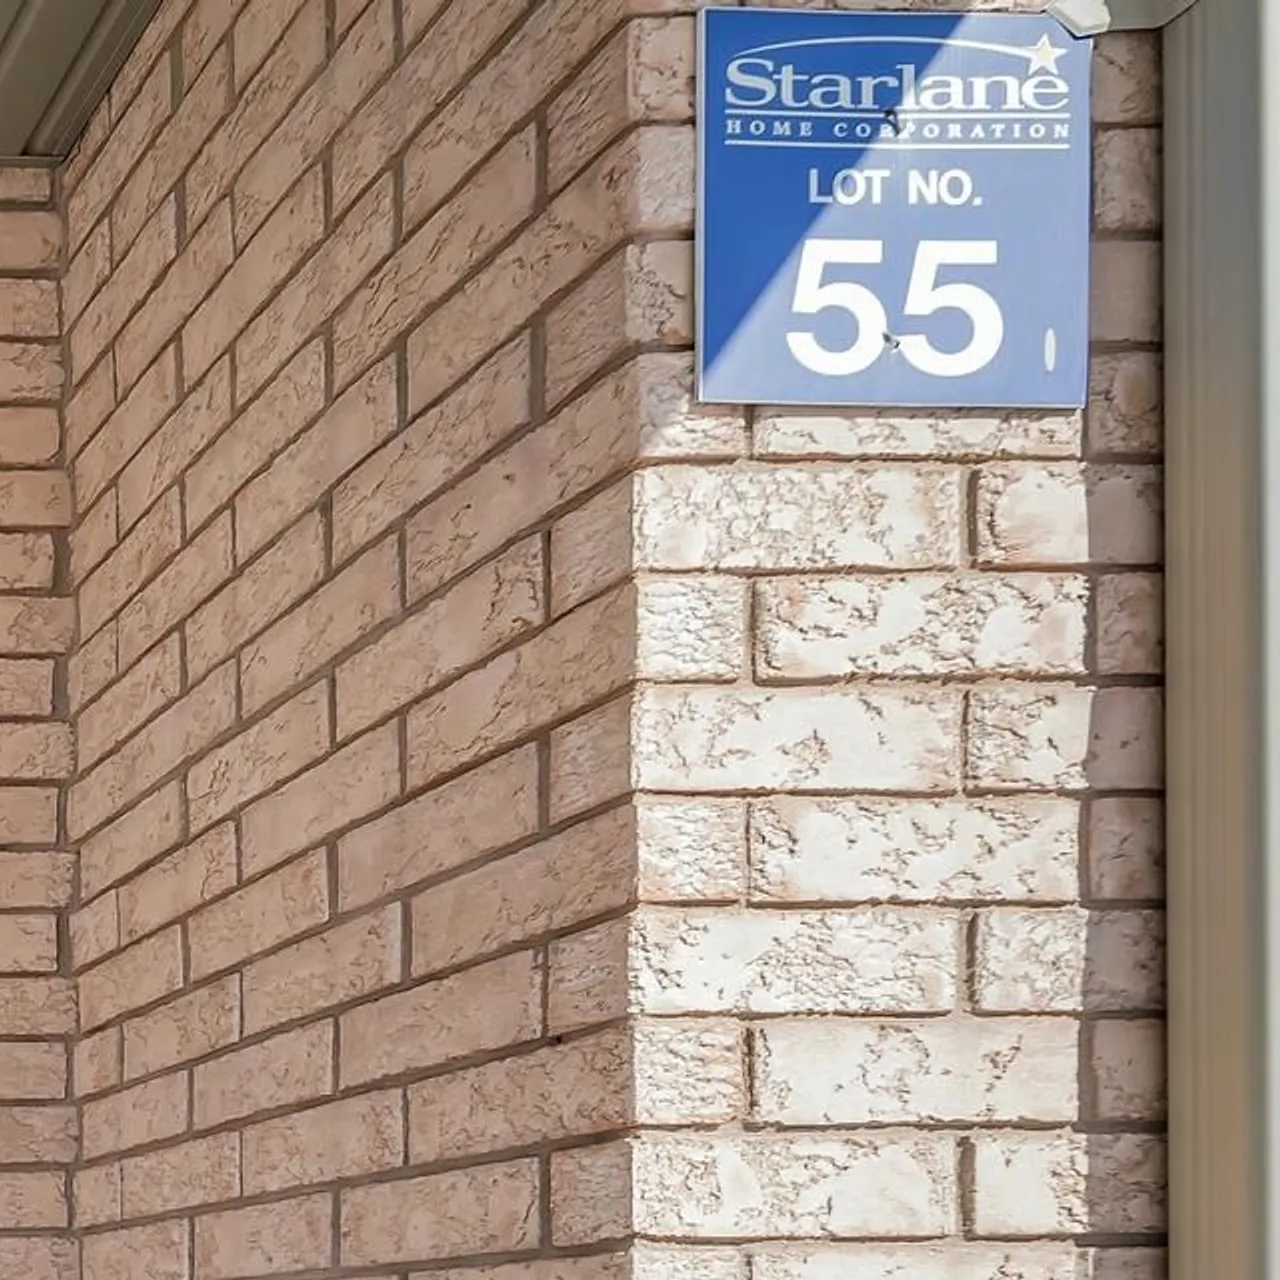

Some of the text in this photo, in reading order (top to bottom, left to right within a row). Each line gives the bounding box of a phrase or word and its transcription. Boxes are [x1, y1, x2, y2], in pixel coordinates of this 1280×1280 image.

[725, 58, 1070, 111] Starlane
[726, 121, 1070, 139] HOME CORPORATION
[808, 168, 983, 206] LOT NO.
[785, 238, 1004, 378] 55
